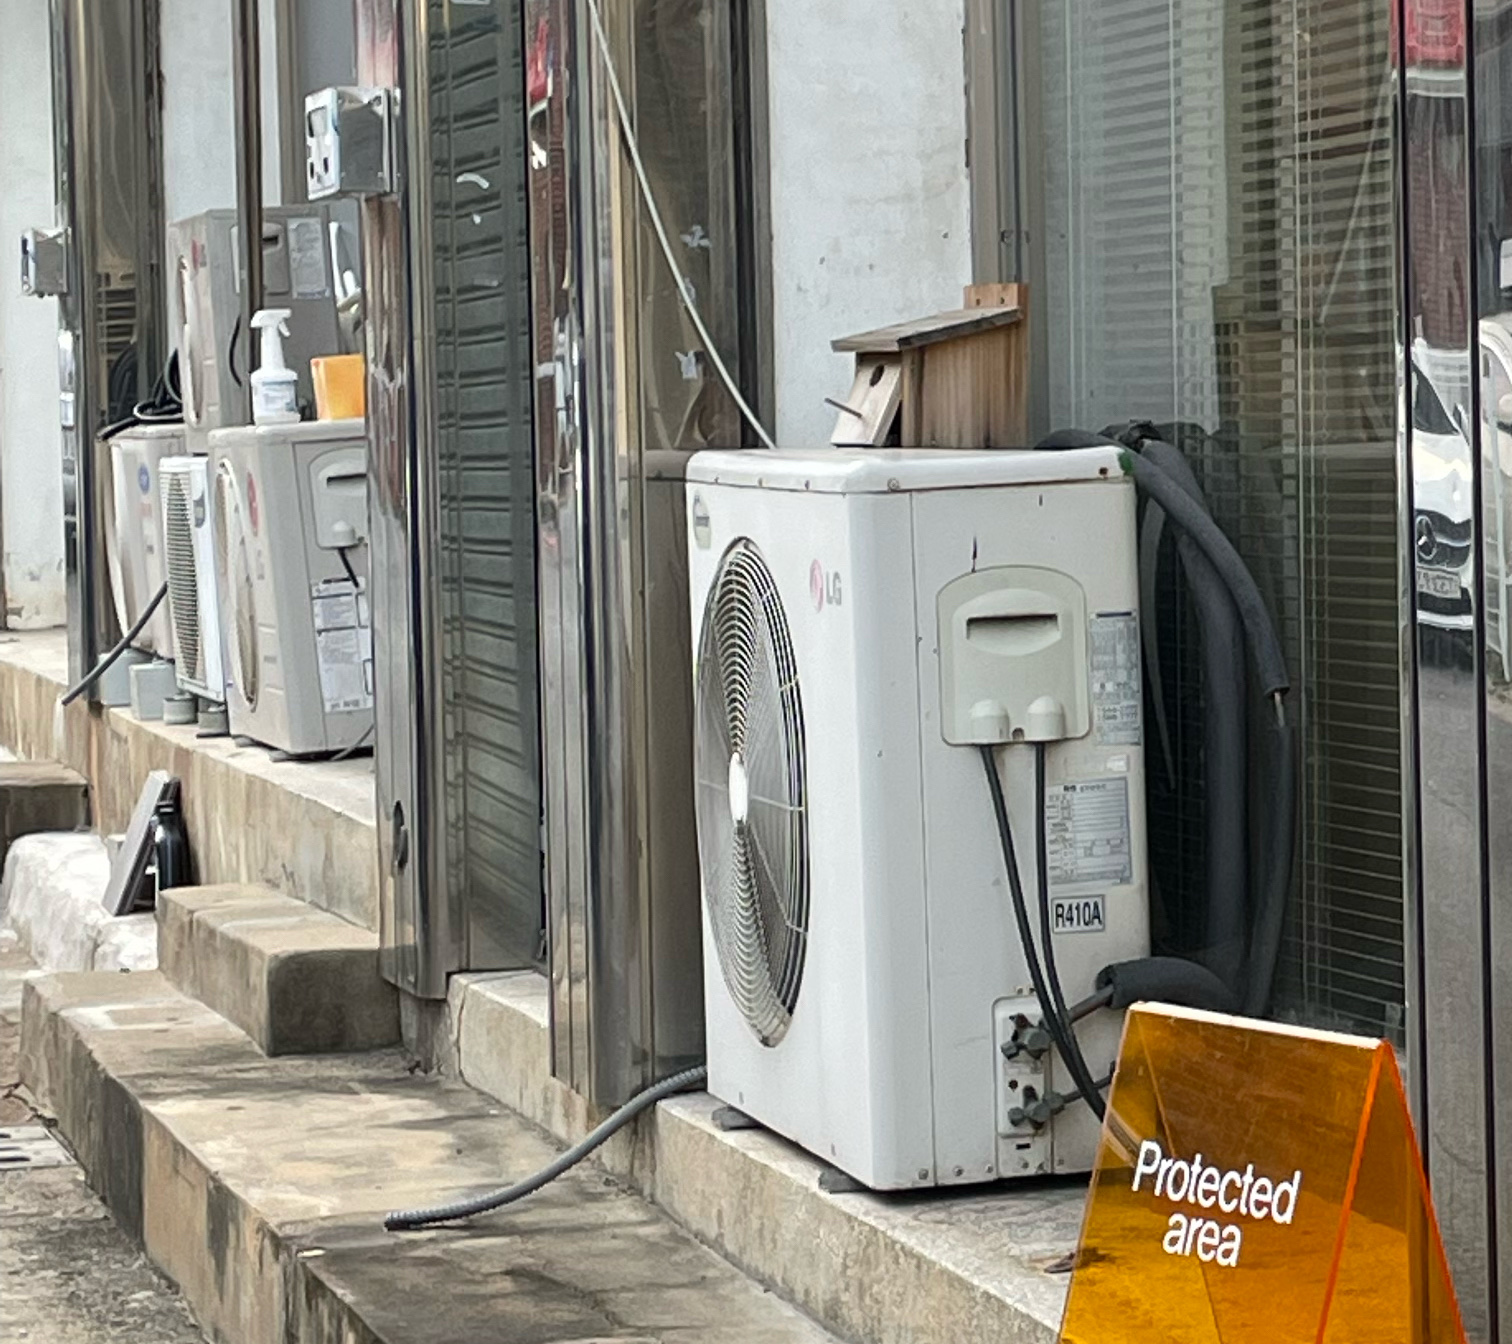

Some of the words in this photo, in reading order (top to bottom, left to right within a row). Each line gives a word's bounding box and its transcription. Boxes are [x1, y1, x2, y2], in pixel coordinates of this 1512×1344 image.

[826, 571, 842, 606] LG
[1055, 901, 1103, 928] R410A
[1131, 1139, 1302, 1225] Protected
[1162, 1212, 1242, 1268] area
